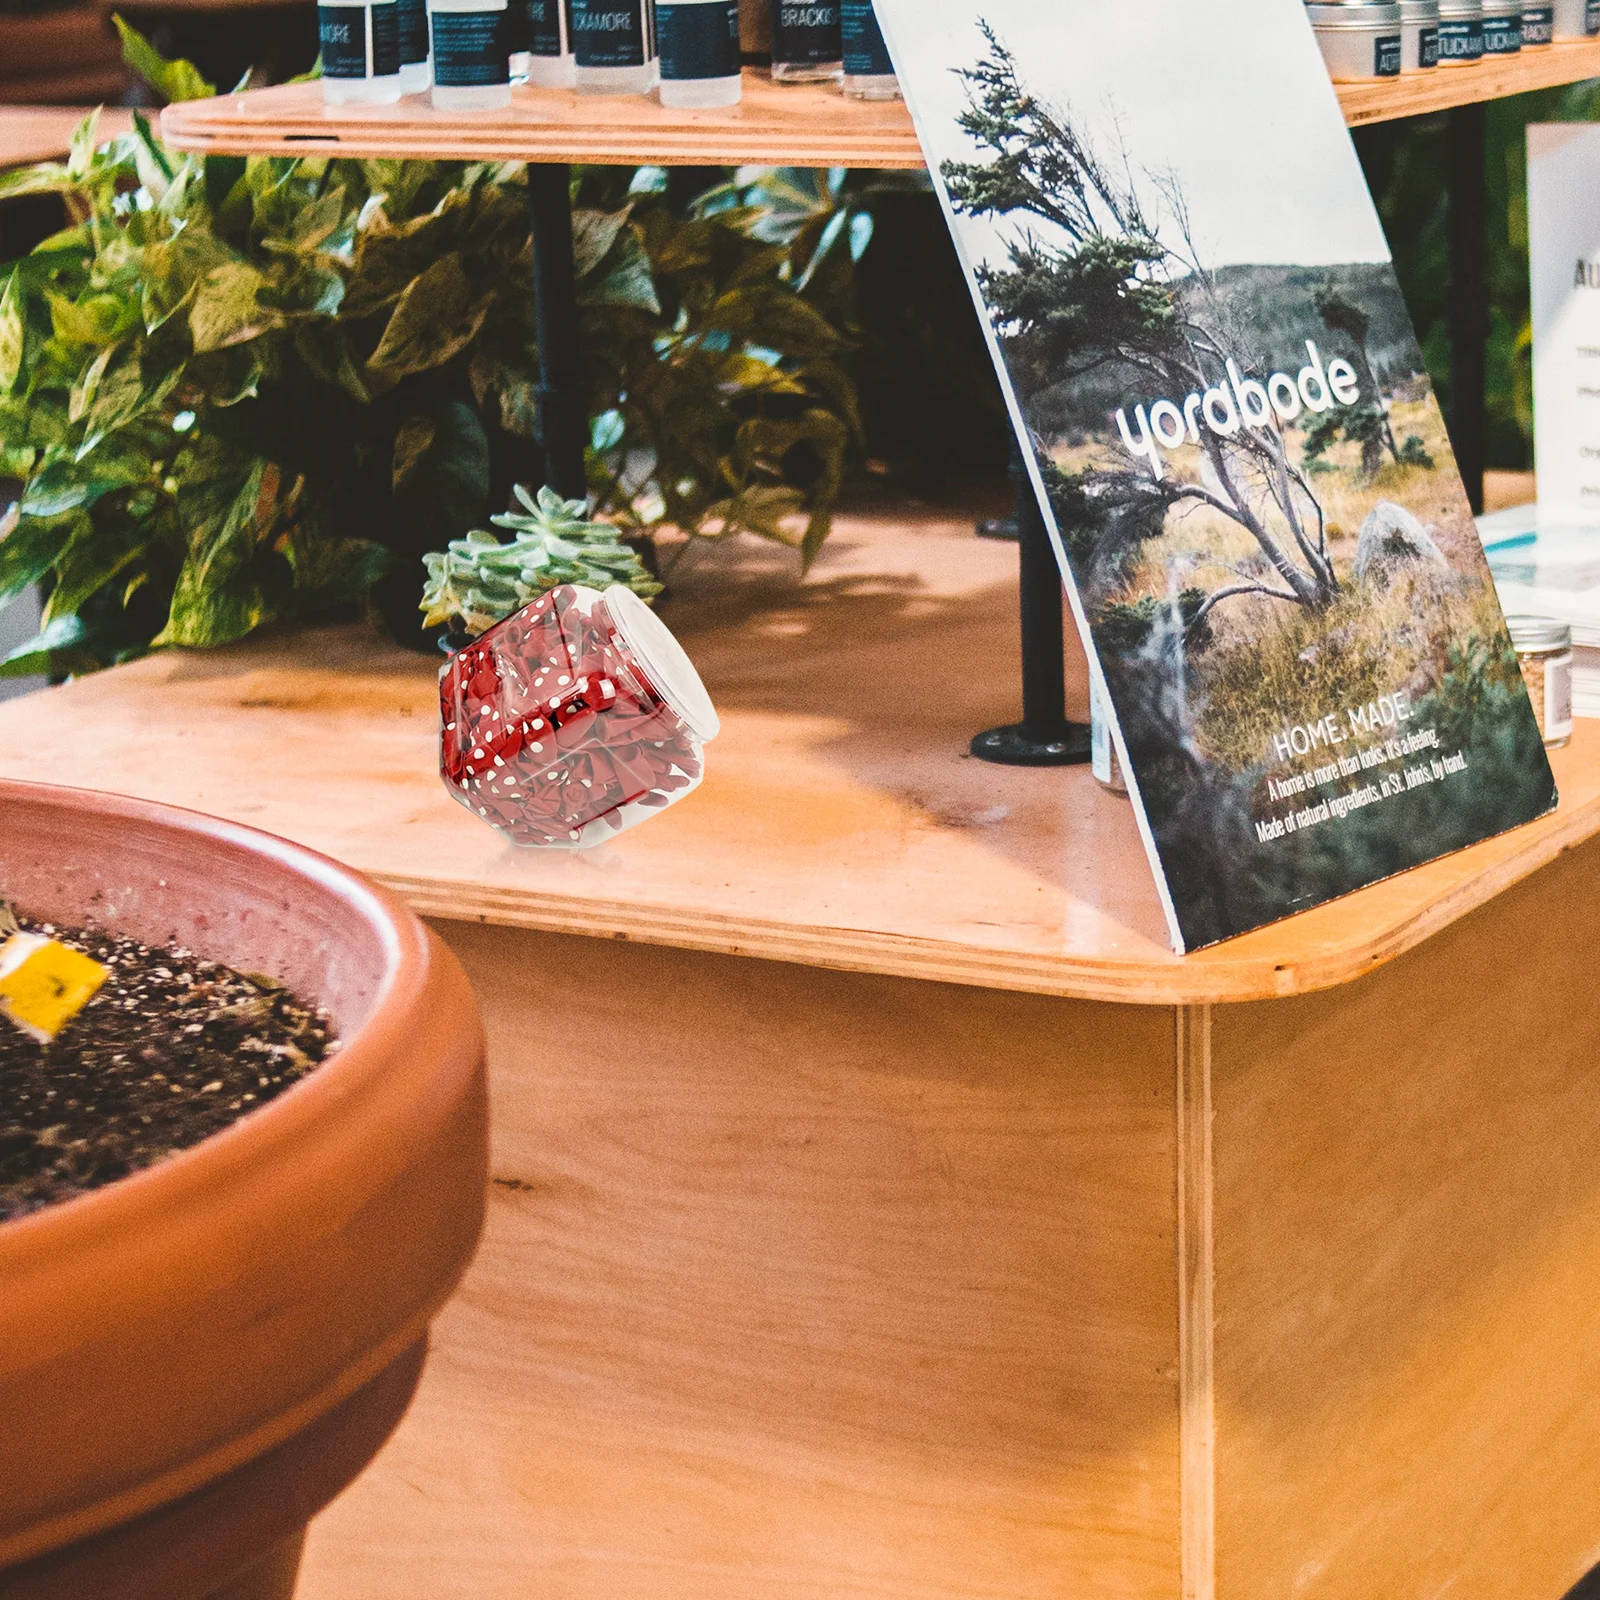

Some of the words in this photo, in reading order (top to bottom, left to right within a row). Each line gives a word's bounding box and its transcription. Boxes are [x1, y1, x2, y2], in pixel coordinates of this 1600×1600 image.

[1115, 339, 1360, 481] yorabode
[1267, 780, 1279, 802] A
[1275, 775, 1306, 799] home
[1303, 770, 1316, 790] is
[1314, 763, 1340, 786] more
[1337, 755, 1361, 777] than
[1384, 738, 1402, 761] it's
[1401, 738, 1409, 755] a
[1406, 728, 1440, 753] feeling.
[1273, 713, 1348, 762] HOME.
[1348, 691, 1415, 736] MADE.
[1254, 816, 1286, 843] Made
[1284, 810, 1297, 834] of
[1295, 798, 1331, 829] natural
[1327, 783, 1383, 819] ingredients,
[1379, 779, 1392, 798] in
[1388, 772, 1406, 795] St.
[1403, 763, 1434, 791] John's,
[1429, 759, 1444, 781] by
[1441, 749, 1468, 775] hand.
